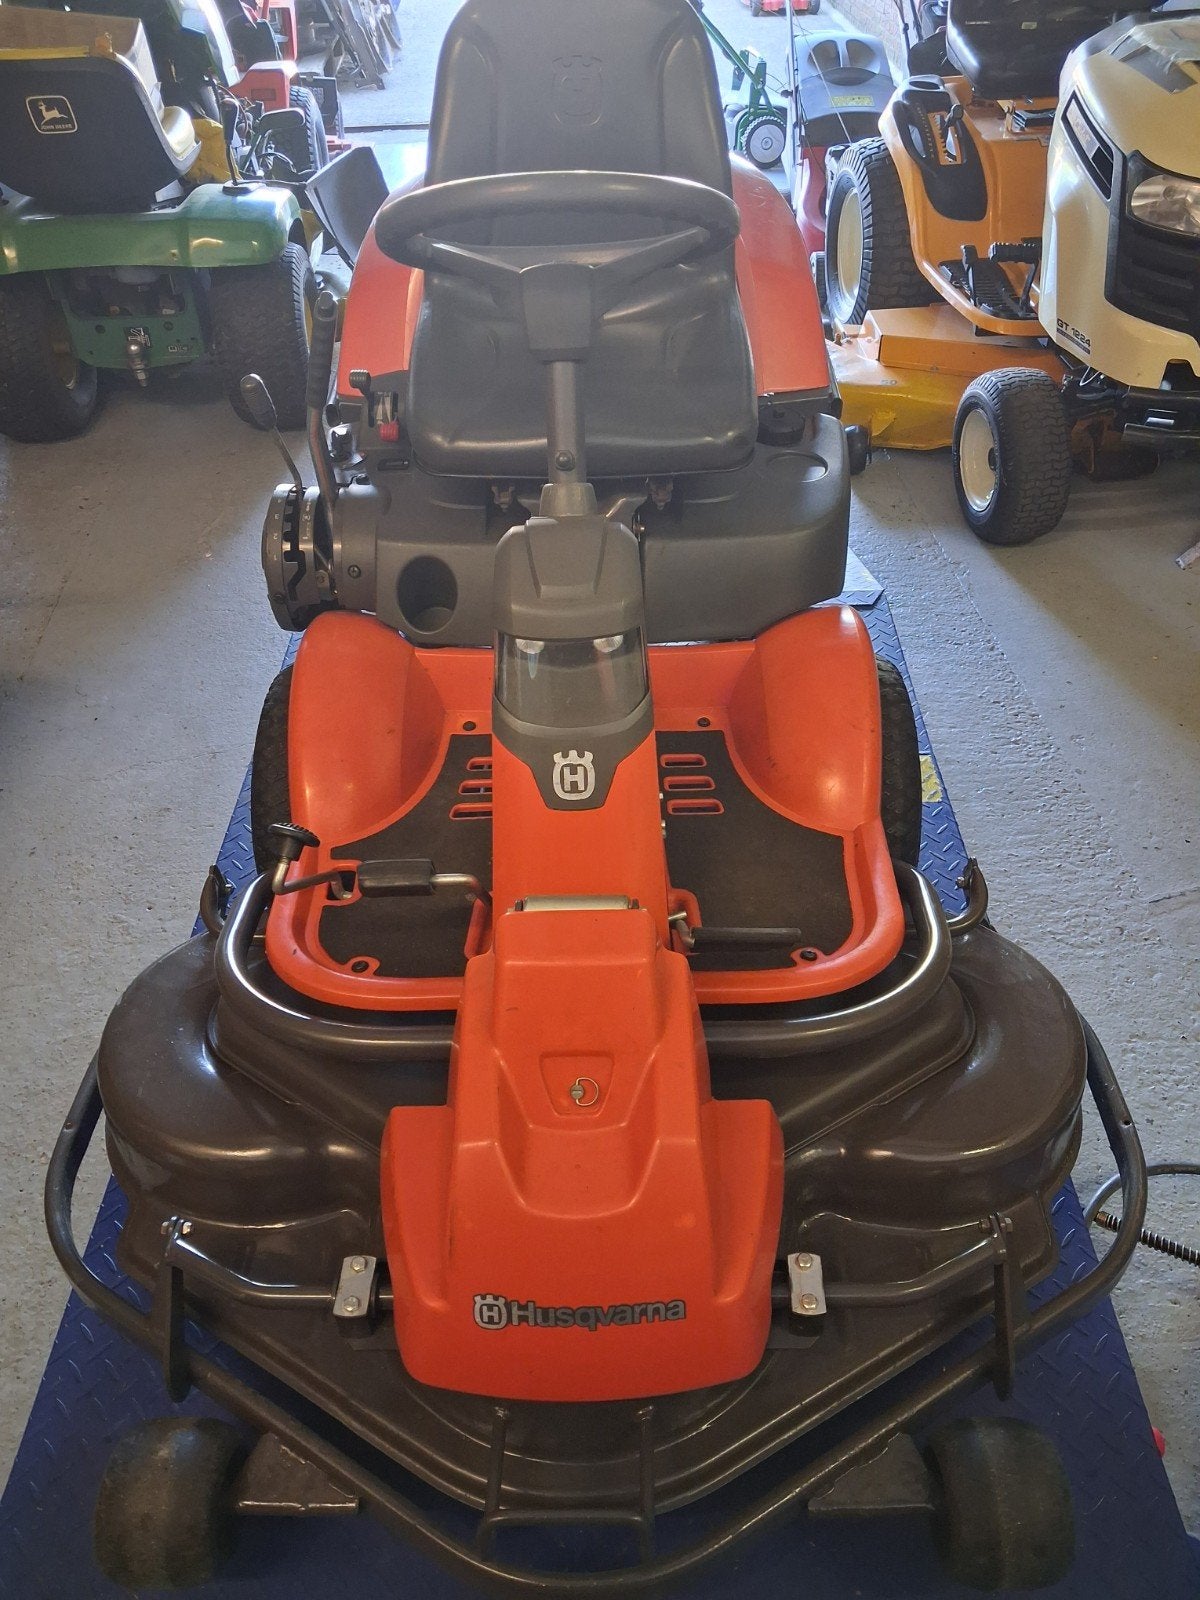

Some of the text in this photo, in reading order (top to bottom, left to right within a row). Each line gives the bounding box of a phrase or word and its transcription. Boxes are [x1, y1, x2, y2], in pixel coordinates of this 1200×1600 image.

[1057, 318, 1070, 330] GT
[1071, 328, 1091, 347] 1224
[511, 1300, 686, 1331] Husqvarna
